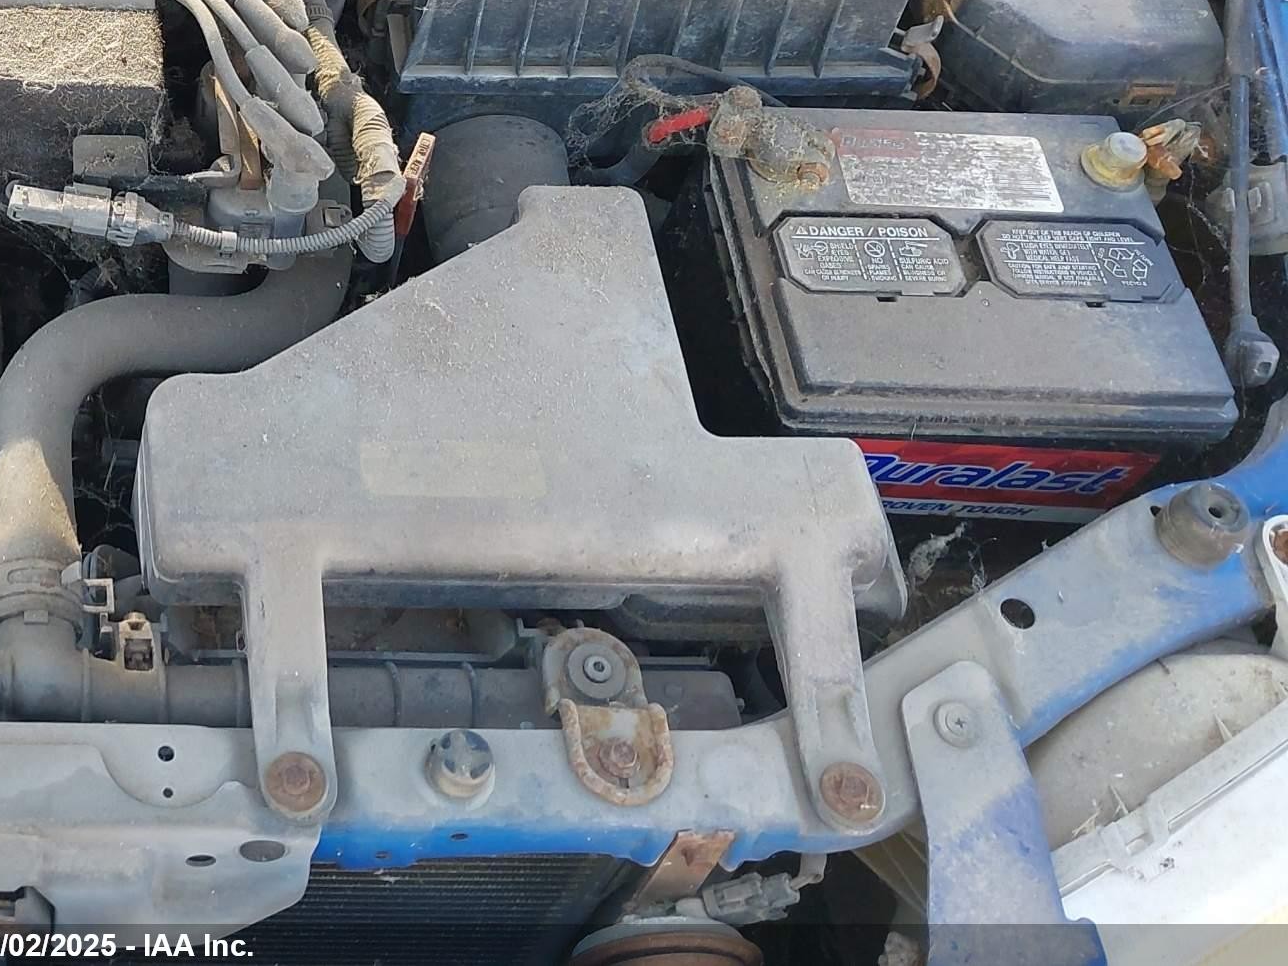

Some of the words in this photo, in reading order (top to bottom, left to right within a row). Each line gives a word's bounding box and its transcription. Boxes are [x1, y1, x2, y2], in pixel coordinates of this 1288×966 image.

[808, 226, 864, 237] DANGER
[867, 226, 874, 236] /
[877, 227, 929, 237] POISON
[958, 504, 1033, 516] TOUGH
